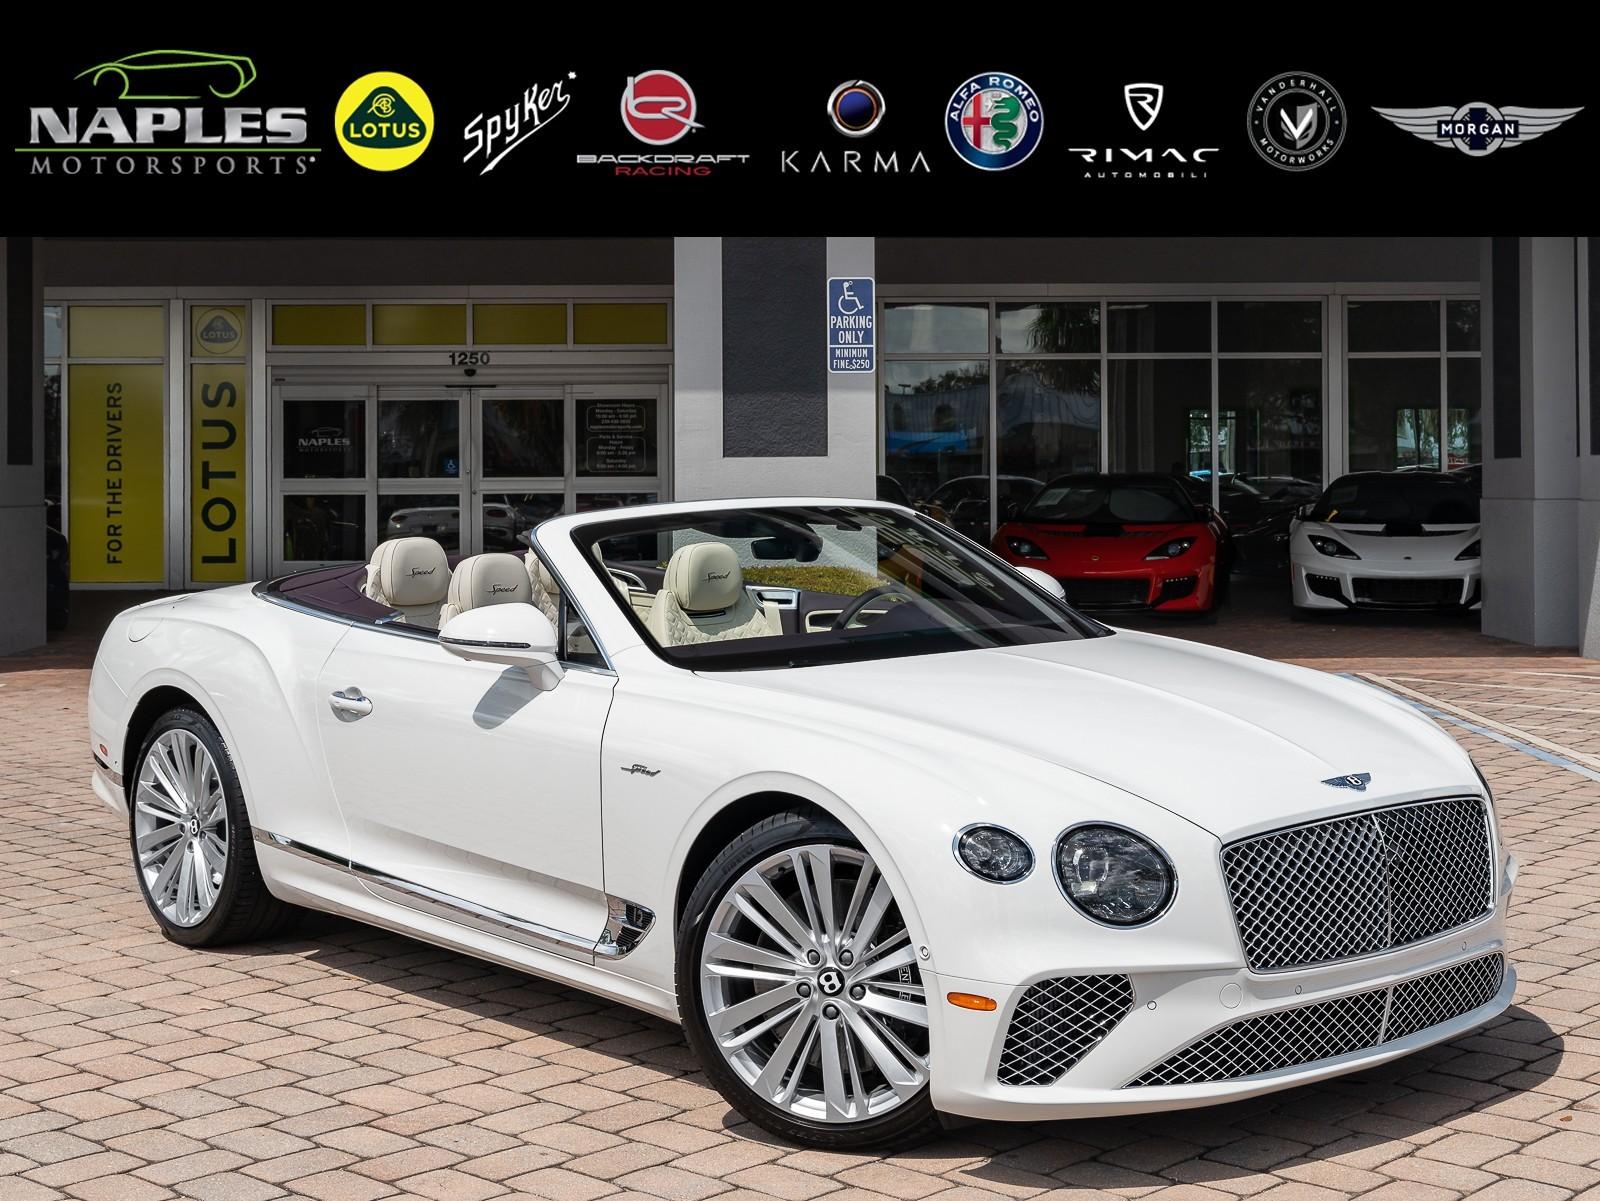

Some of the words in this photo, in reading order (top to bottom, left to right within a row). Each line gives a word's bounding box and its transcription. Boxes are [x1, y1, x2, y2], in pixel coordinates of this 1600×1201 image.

[830, 315, 873, 329] PARKING
[202, 330, 236, 340] LOTUS
[838, 330, 865, 344] ONLY
[448, 351, 490, 366] 1250
[835, 348, 868, 358] MINIMUM
[833, 359, 849, 369] FINE
[852, 358, 870, 369] $250
[107, 382, 123, 472] DRIVERS
[298, 437, 352, 447] NAPLES
[201, 381, 237, 564] LOTUS
[107, 478, 123, 518] THE
[107, 524, 123, 564] FOR
[405, 567, 436, 578] Speed
[701, 570, 731, 583] Speed
[485, 584, 518, 596] Speed
